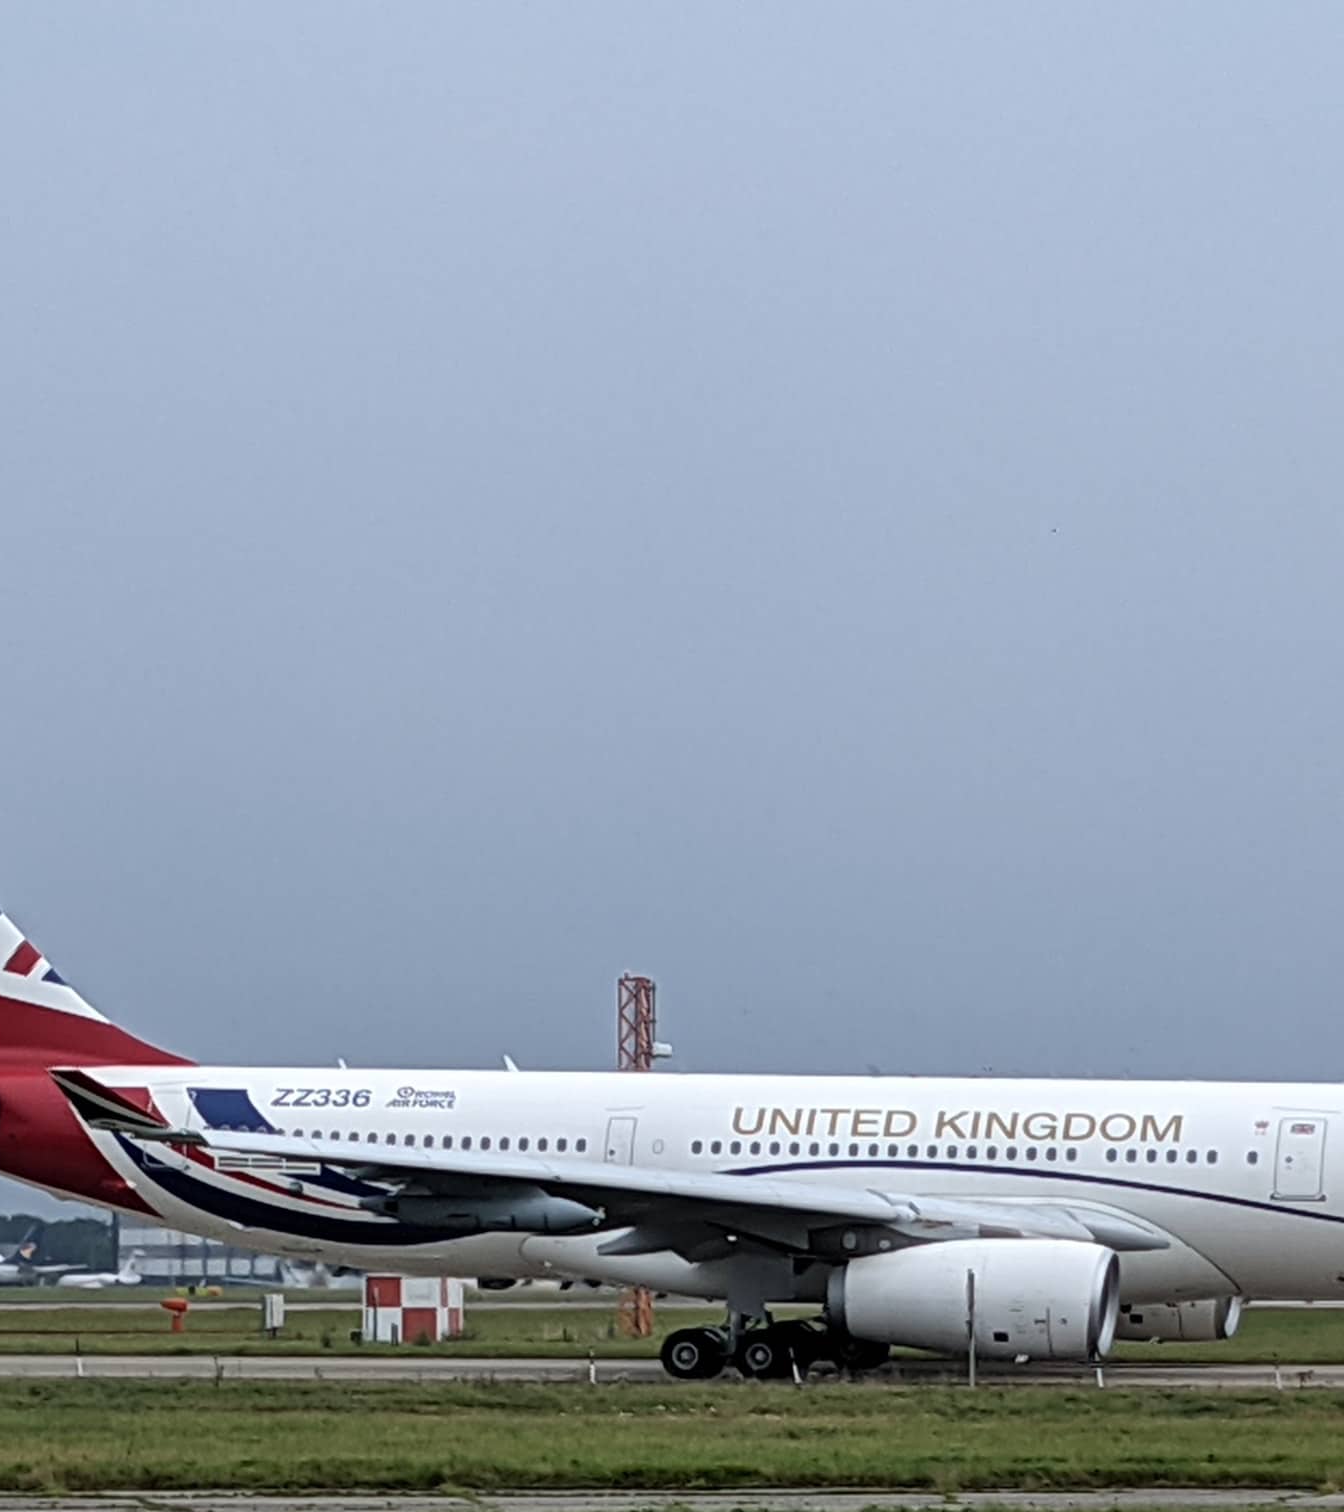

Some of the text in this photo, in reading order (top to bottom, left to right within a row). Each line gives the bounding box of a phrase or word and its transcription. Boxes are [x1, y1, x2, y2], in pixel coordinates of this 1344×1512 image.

[270, 1088, 372, 1107] ZZ336
[731, 1107, 1184, 1143] UNITED KINGDOM
